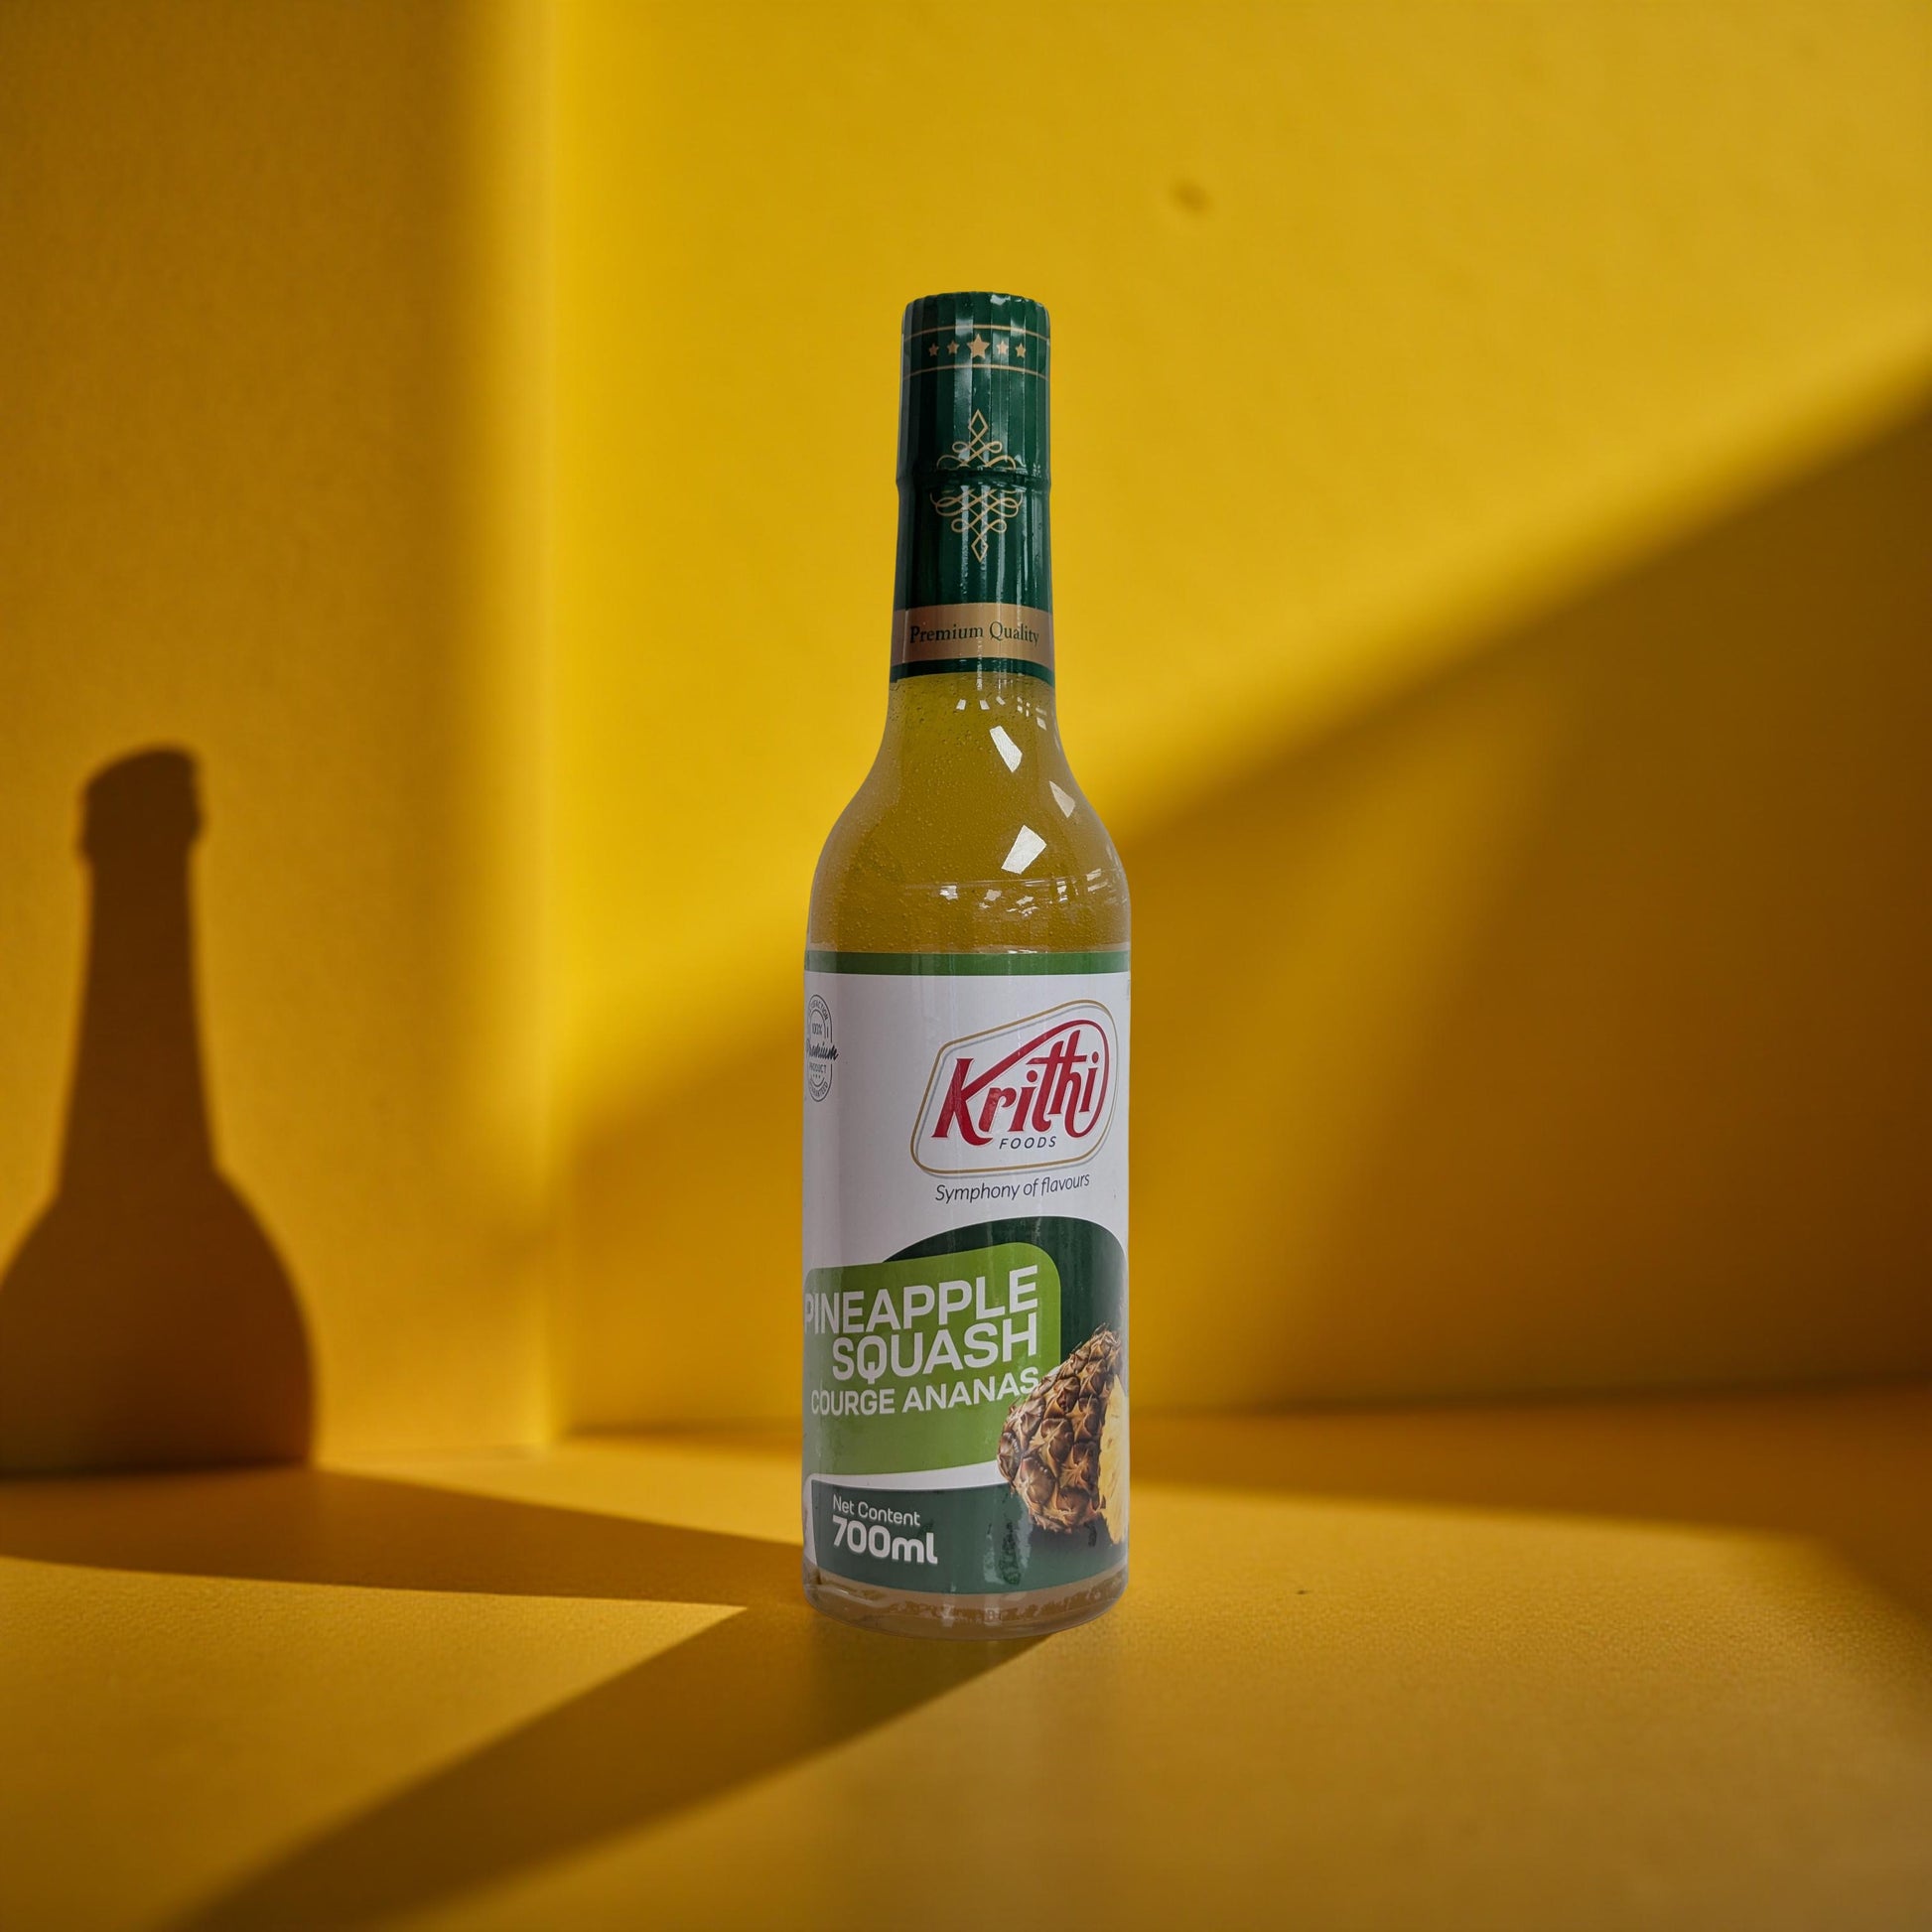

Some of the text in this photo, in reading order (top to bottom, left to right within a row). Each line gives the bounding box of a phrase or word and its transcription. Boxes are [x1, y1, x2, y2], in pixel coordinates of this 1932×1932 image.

[910, 621, 1039, 645] Premium Quality
[931, 1019, 1109, 1146] Krithi
[999, 1136, 1056, 1150] FOODS
[935, 1173, 1090, 1203] Symphony of flavours
[804, 1265, 1038, 1334] PINEAPPLE
[832, 1312, 1037, 1384] SQUASH
[811, 1366, 1039, 1416] COURGE ANANAS
[832, 1494, 920, 1527] Net Content
[832, 1515, 938, 1565] 700ml
